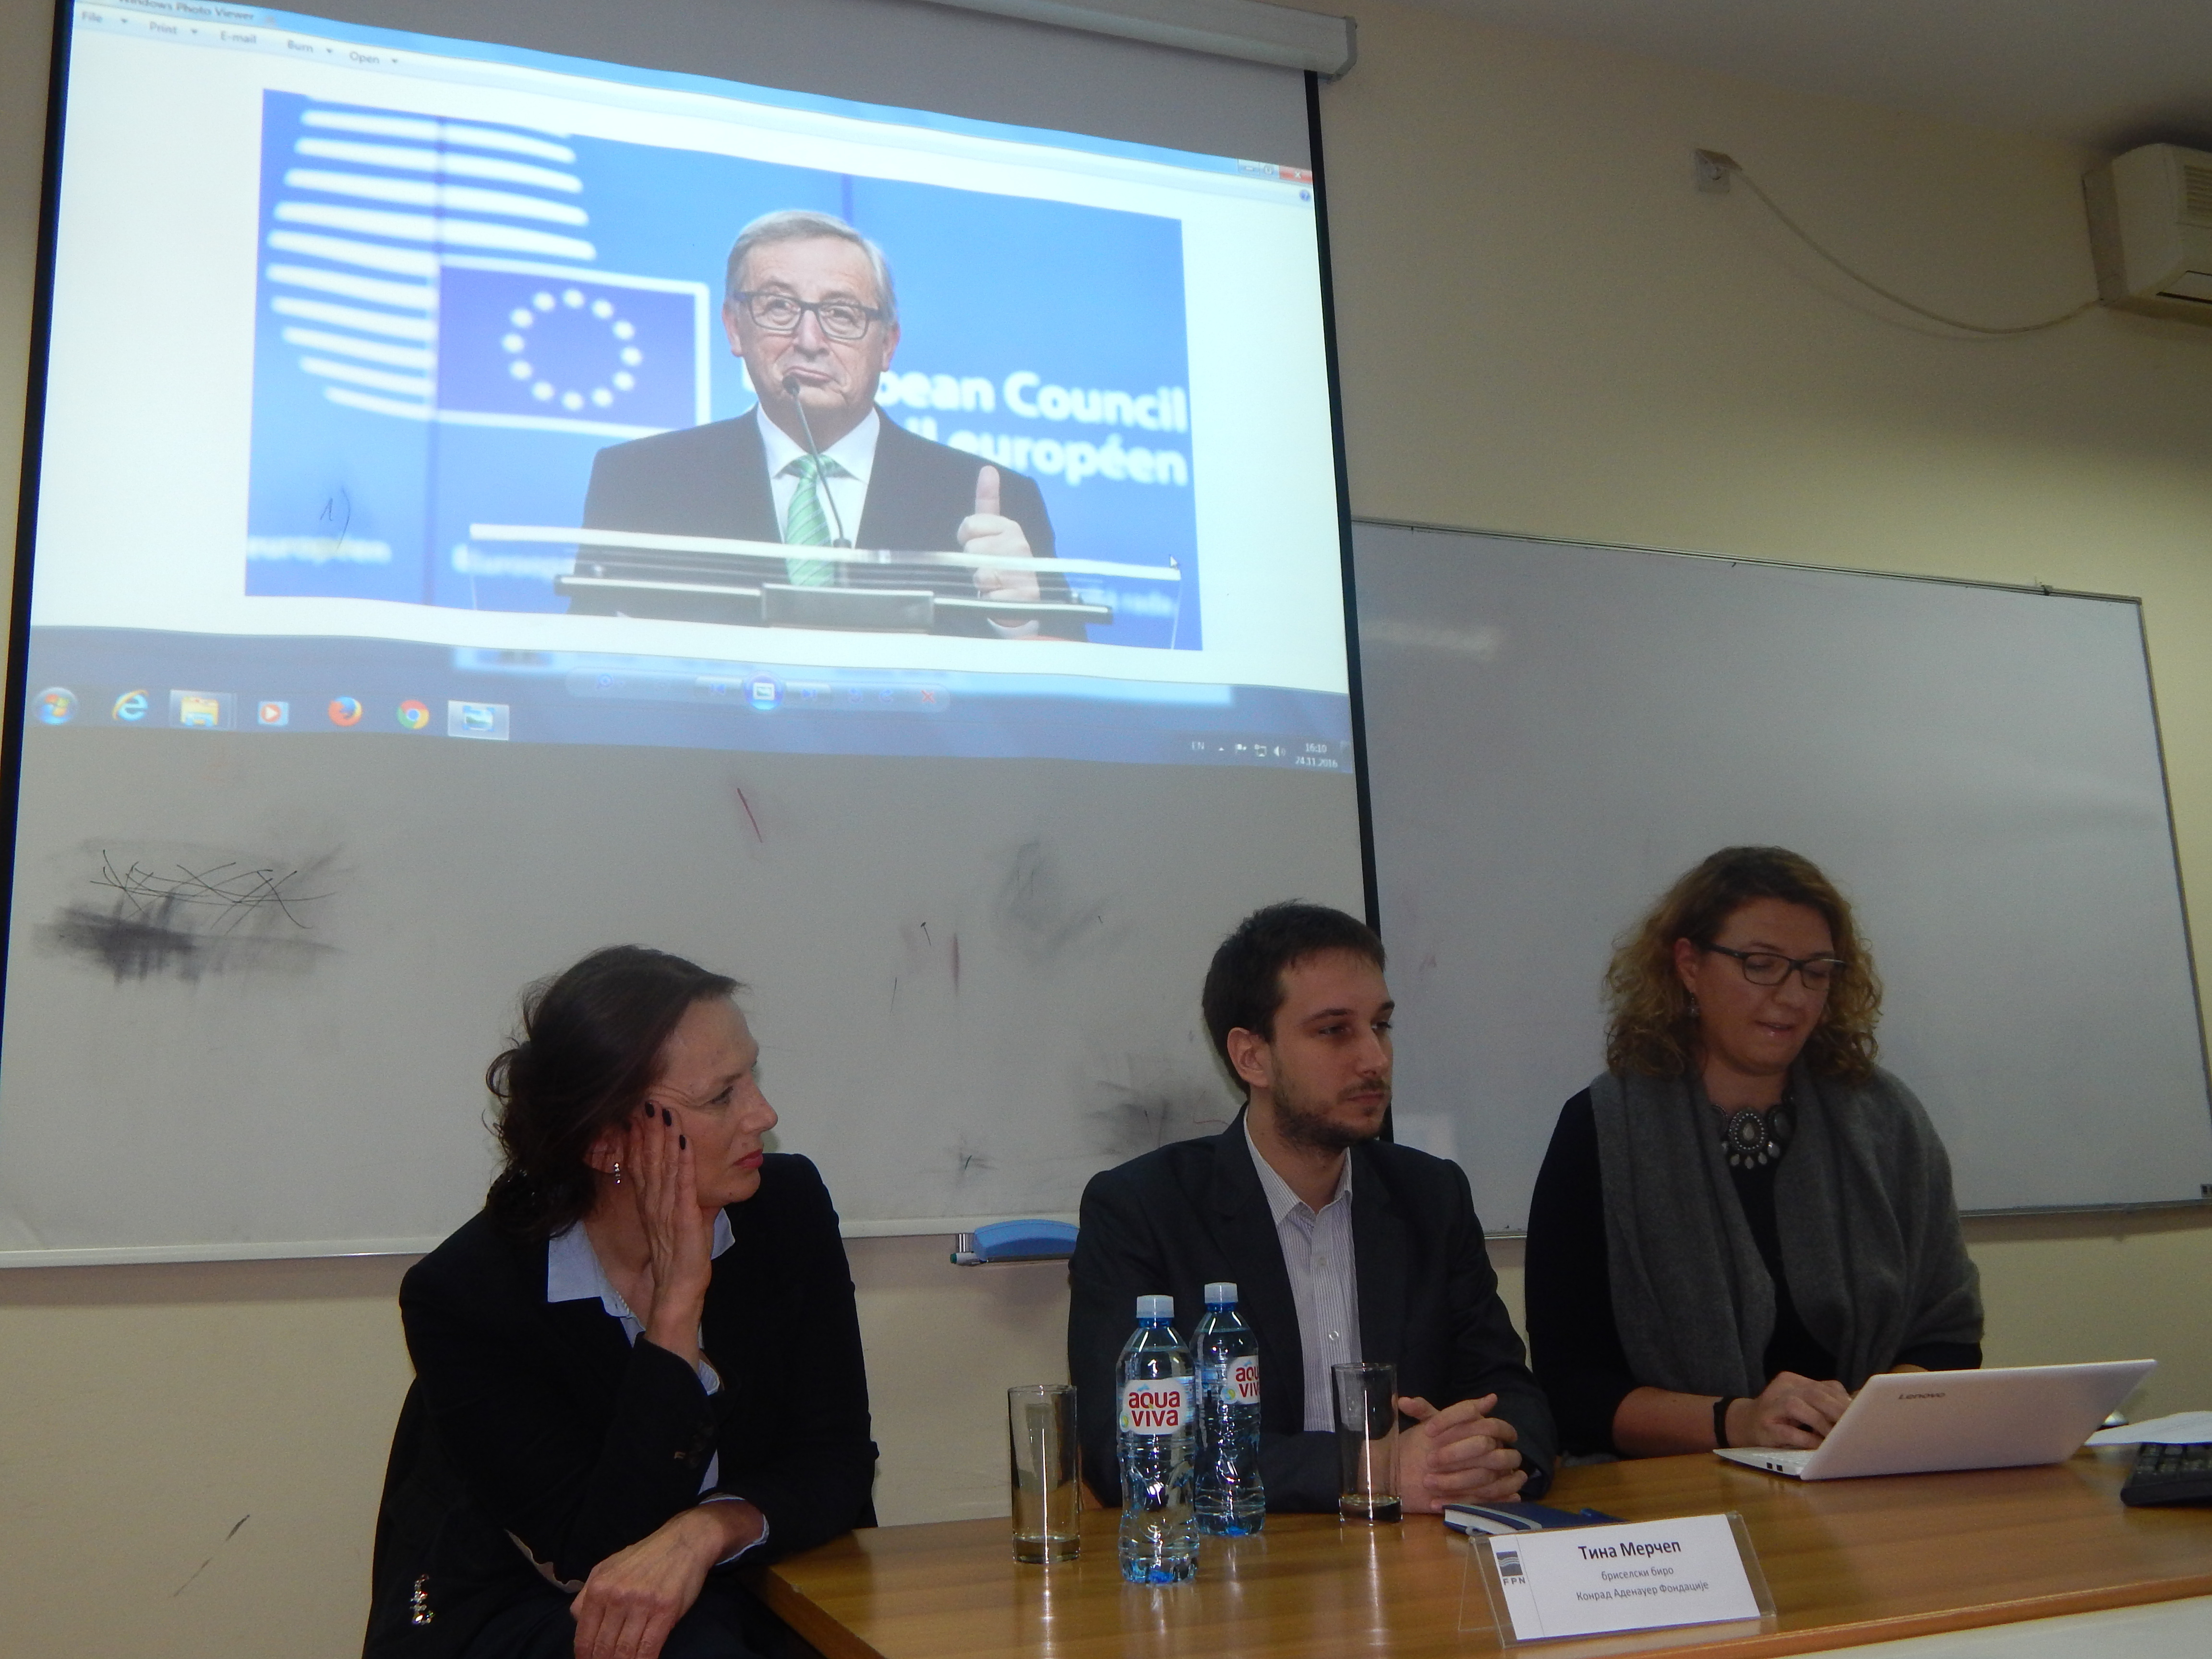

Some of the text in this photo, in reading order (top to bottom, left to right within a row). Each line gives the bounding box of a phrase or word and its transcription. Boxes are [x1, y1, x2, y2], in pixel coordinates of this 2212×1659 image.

[176, 2, 212, 15] Photo
[215, 7, 254, 20] Viewer
[81, 11, 380, 65] File Print E-mail Burn Open
[1002, 370, 1188, 433] Council
[947, 430, 1189, 487] européen
[1305, 743, 1327, 753] 16:10
[1577, 1541, 1682, 1560] Тина Мерчеп
[1601, 1566, 1674, 1582] бриселски биро
[1576, 1580, 1709, 1601] Конрад Аденауер Фондације
